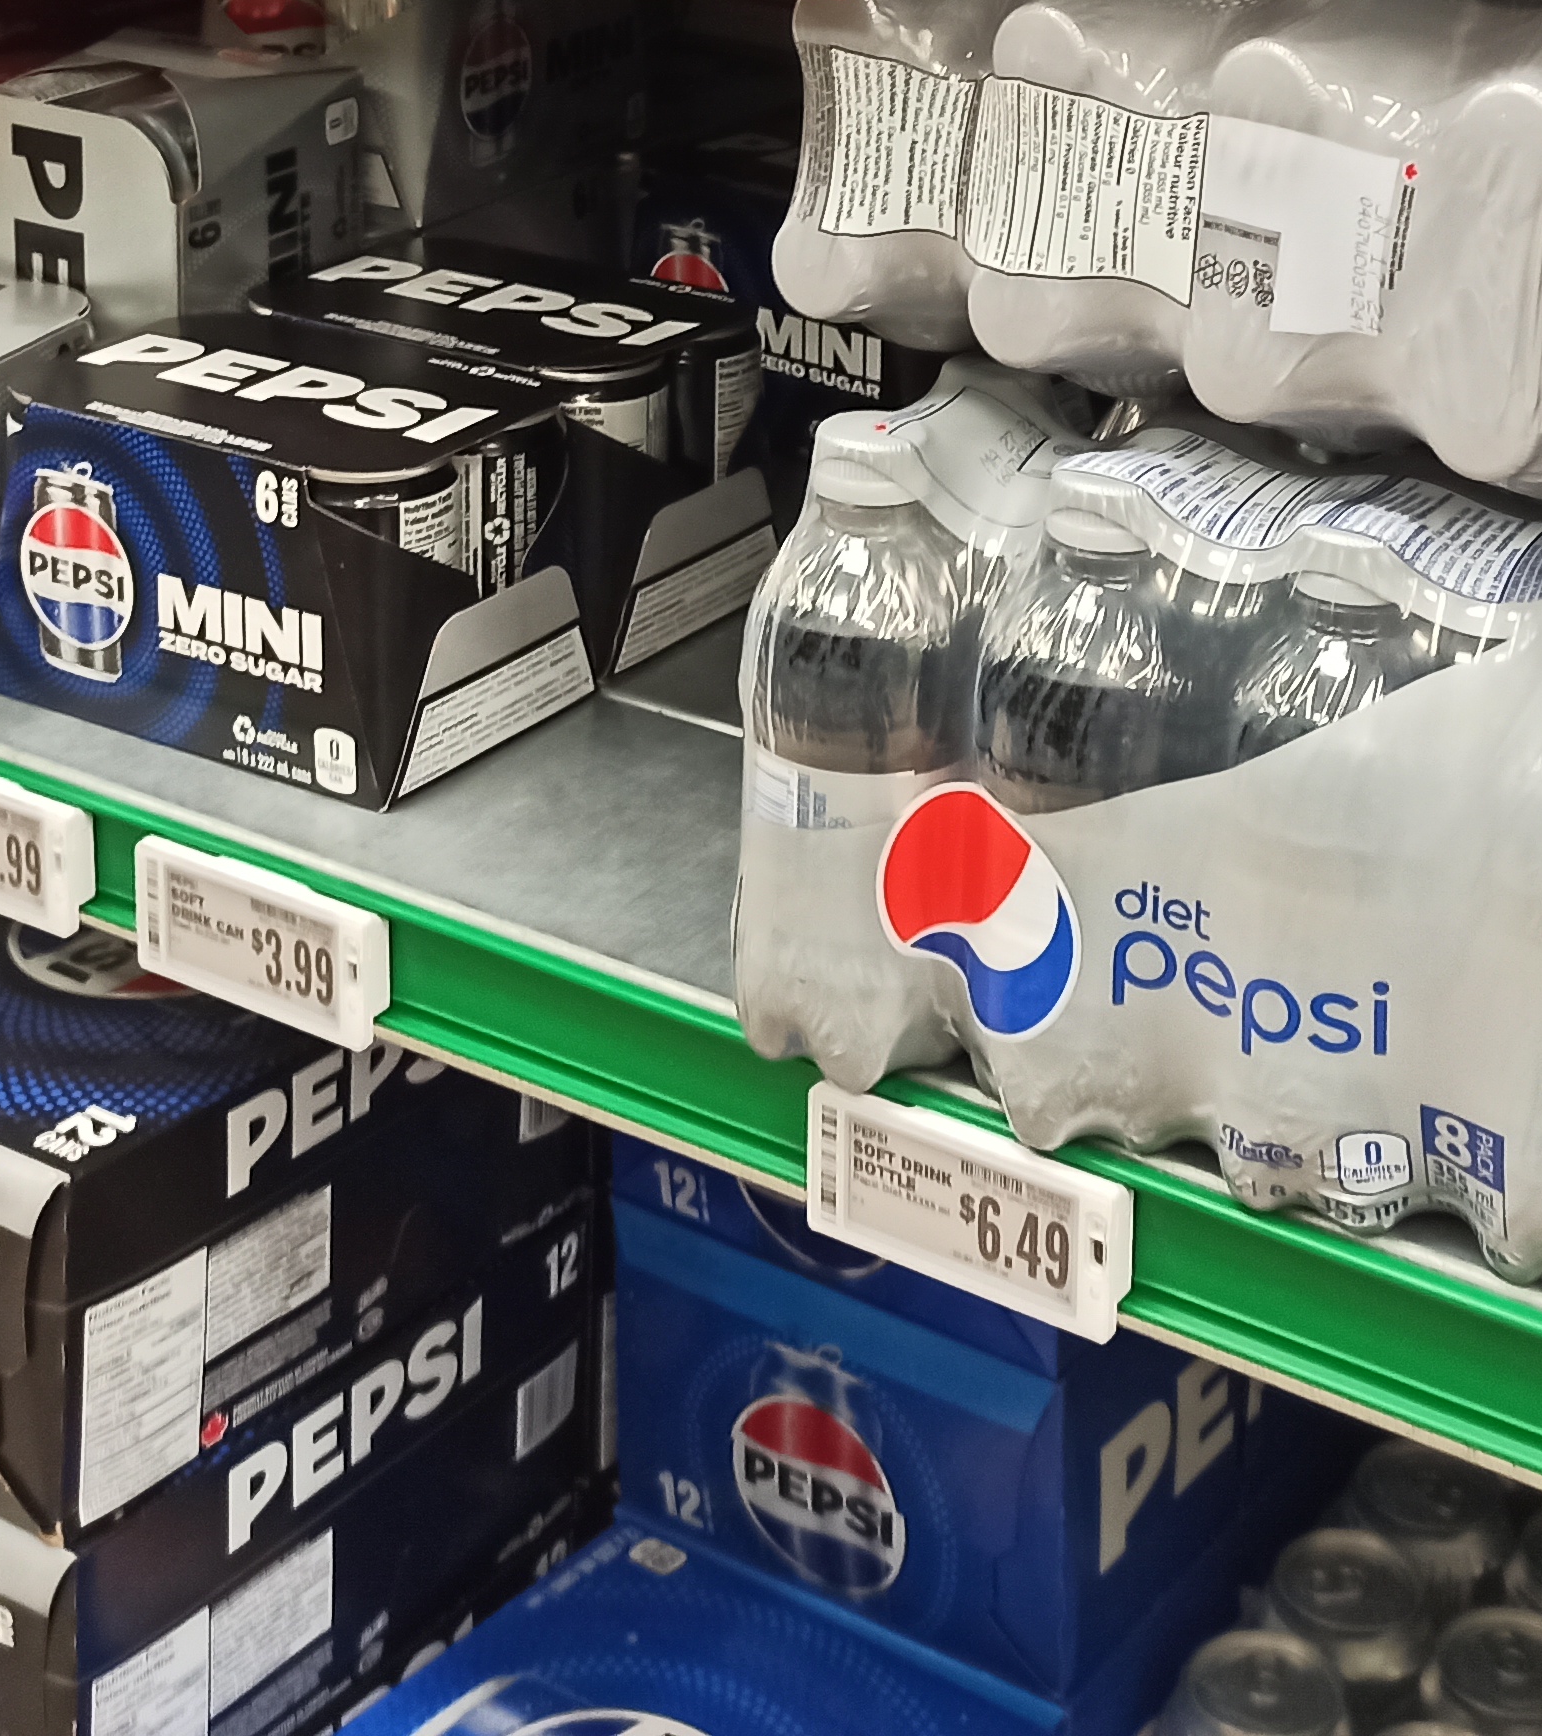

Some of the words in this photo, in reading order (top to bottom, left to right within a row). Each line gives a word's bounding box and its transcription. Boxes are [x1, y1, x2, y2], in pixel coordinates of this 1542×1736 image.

[1173, 121, 1193, 170] Valeur
[1186, 118, 1206, 191] Nutrition
[1165, 174, 1182, 240] nutritive
[1181, 195, 1196, 240] Facts
[309, 256, 702, 348] PEPSI
[757, 307, 883, 383] MINI
[77, 333, 499, 445] PEPSI
[809, 366, 882, 401] SUGAR
[254, 471, 281, 524] 6
[29, 549, 127, 603] PEPSI
[156, 574, 325, 673] MINI
[158, 630, 226, 669] ZERO
[229, 649, 324, 695] SUGAR
[1113, 881, 1211, 942] diet
[251, 926, 335, 1007] $3.99
[1112, 929, 1391, 1057] pepsi
[227, 1039, 449, 1200] PEPS
[1364, 1139, 1383, 1166] 0
[1433, 1114, 1473, 1169] 8
[1475, 1127, 1495, 1185] PACK
[655, 1162, 702, 1216] 12
[852, 1138, 896, 1166] SOFT
[900, 1155, 953, 1189] DRINK
[852, 1155, 917, 1192] BOTTLE
[545, 1231, 579, 1299] 12
[958, 1192, 1070, 1290] $6.49
[227, 1294, 484, 1557] PEPSI
[658, 1470, 706, 1527] 12
[743, 1436, 899, 1551] PEPSI
